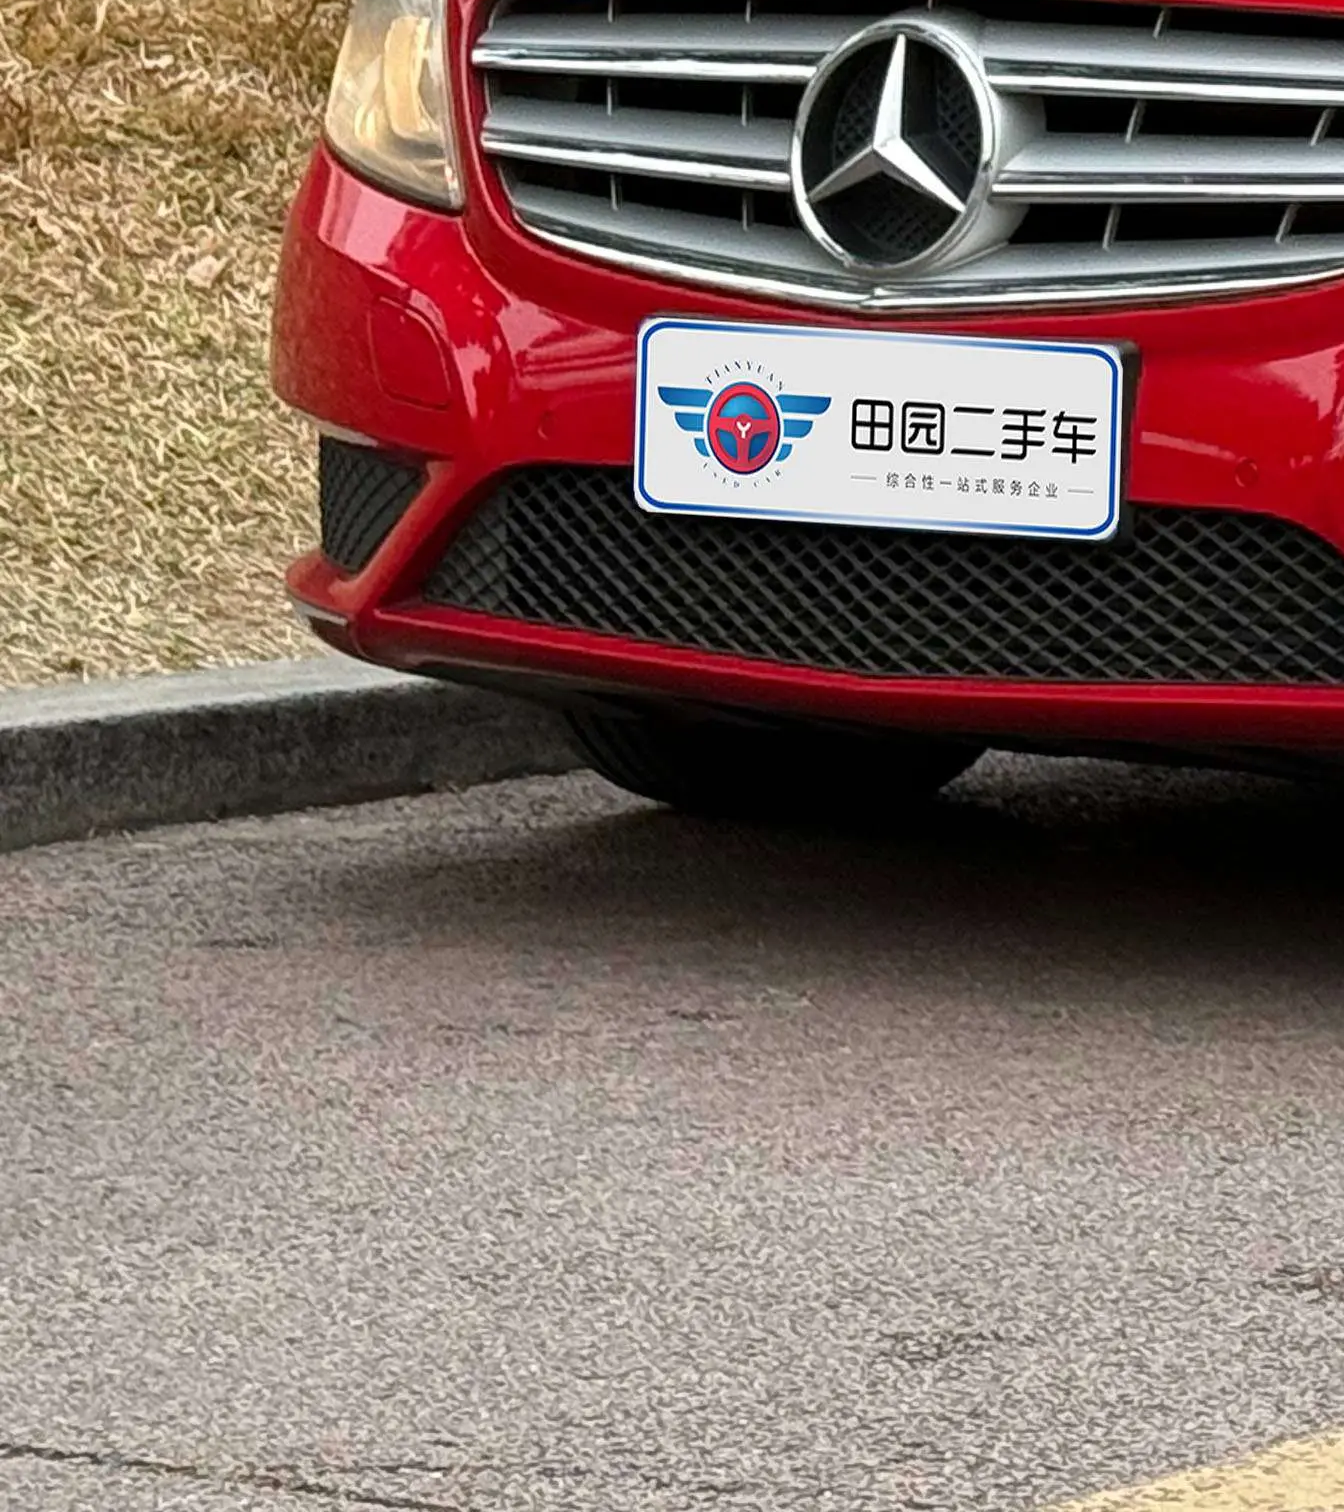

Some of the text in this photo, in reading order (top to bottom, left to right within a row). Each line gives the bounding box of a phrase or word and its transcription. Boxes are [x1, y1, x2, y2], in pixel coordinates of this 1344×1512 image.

[851, 398, 1098, 464] 田园二手车
[886, 472, 1059, 498] 综合性一站式服务企业
